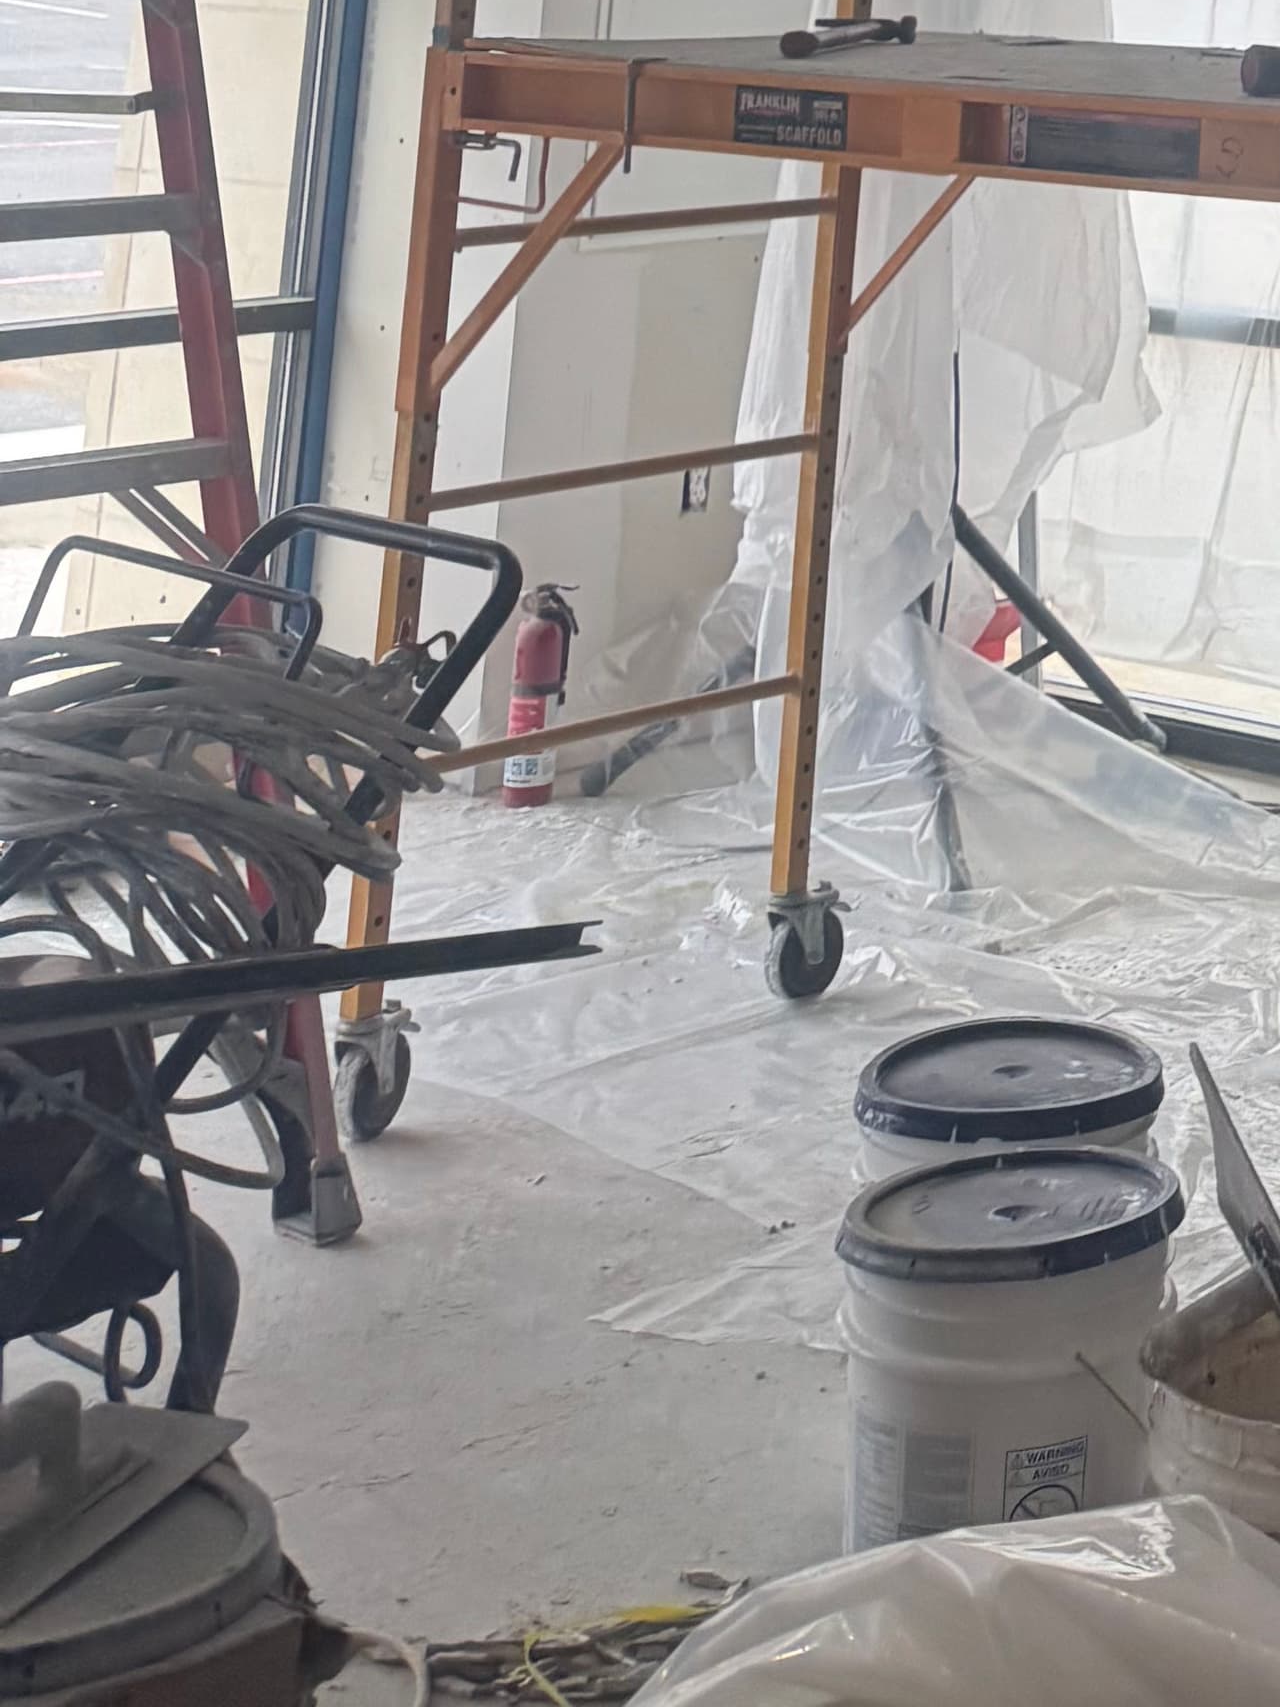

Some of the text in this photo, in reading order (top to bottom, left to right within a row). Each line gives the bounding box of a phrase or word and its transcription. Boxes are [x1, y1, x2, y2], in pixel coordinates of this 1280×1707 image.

[740, 92, 801, 114] FRANKLIN
[776, 125, 842, 146] SCAFFOLD
[1025, 1440, 1084, 1465] WARNING
[1031, 1463, 1070, 1481] AVISO
